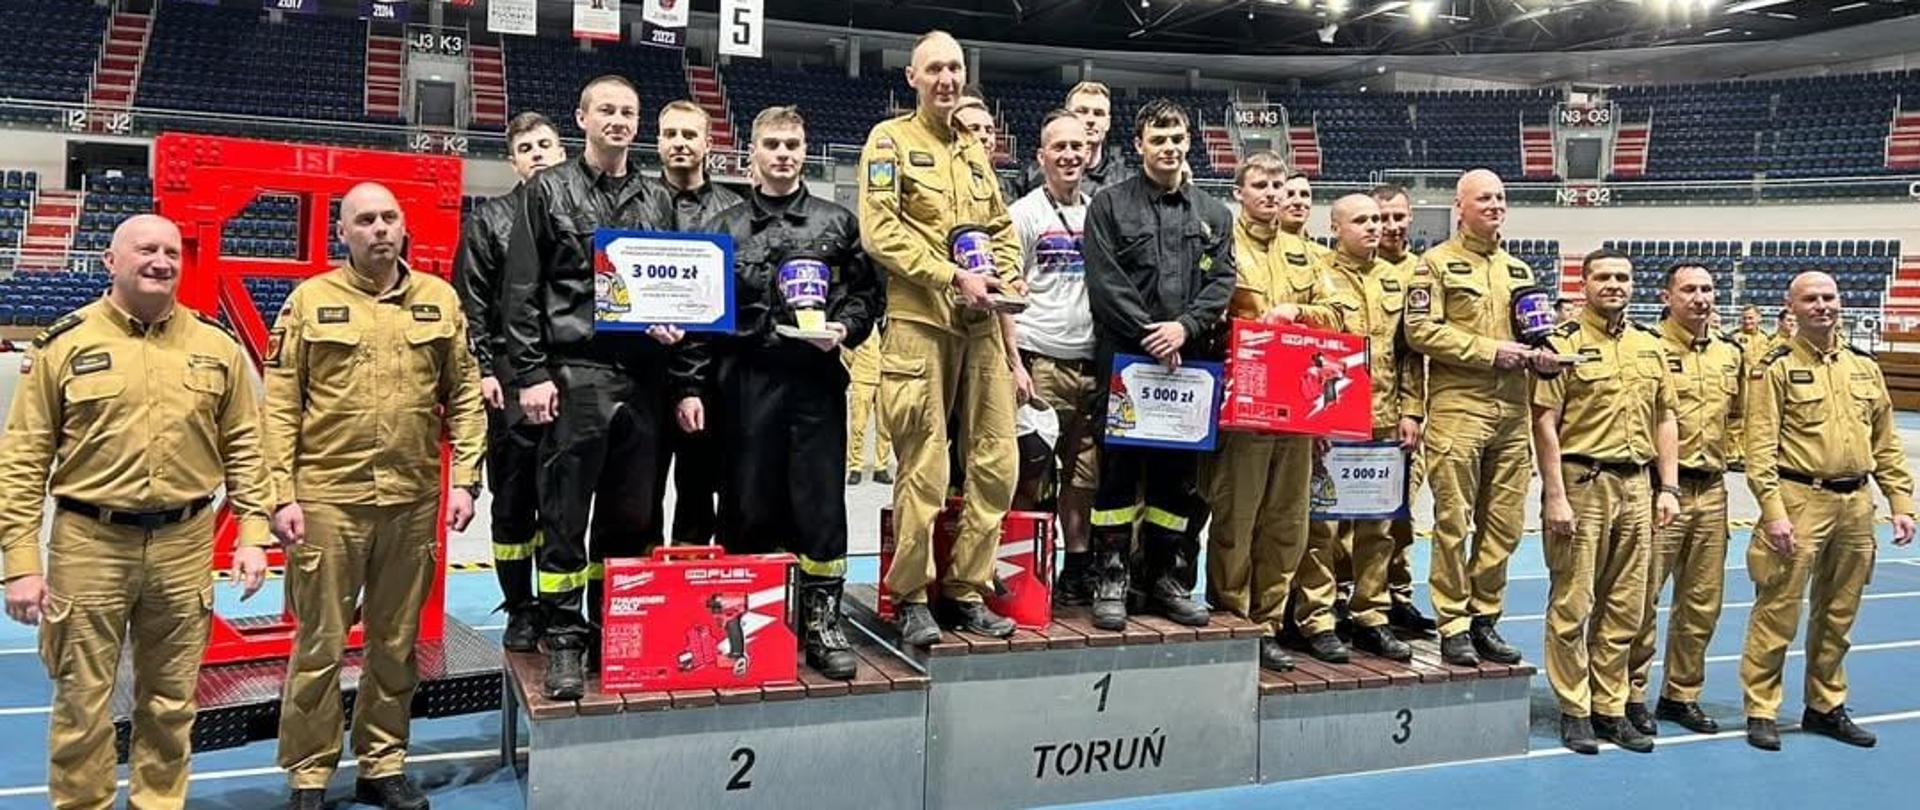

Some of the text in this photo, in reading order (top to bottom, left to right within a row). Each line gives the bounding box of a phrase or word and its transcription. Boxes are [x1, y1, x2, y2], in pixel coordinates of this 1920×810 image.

[733, 8, 751, 44] 5
[414, 33, 462, 51] J3 K3
[106, 113, 129, 130] J2
[1260, 110, 1278, 124] N3
[1561, 109, 1609, 123] N3 O3
[410, 134, 468, 152] J2 K2
[705, 154, 726, 169] K2
[1556, 188, 1578, 204] N2
[632, 264, 699, 279] 3 000 zł
[1303, 336, 1351, 351] FUEL
[1141, 387, 1194, 402] 5 000 zł
[1341, 467, 1389, 479] 2 000 zł
[708, 568, 757, 578] FUEL
[1093, 673, 1111, 712] 1
[1392, 708, 1412, 744] 3
[1033, 727, 1166, 778] TORUŃ
[726, 747, 755, 791] 2
